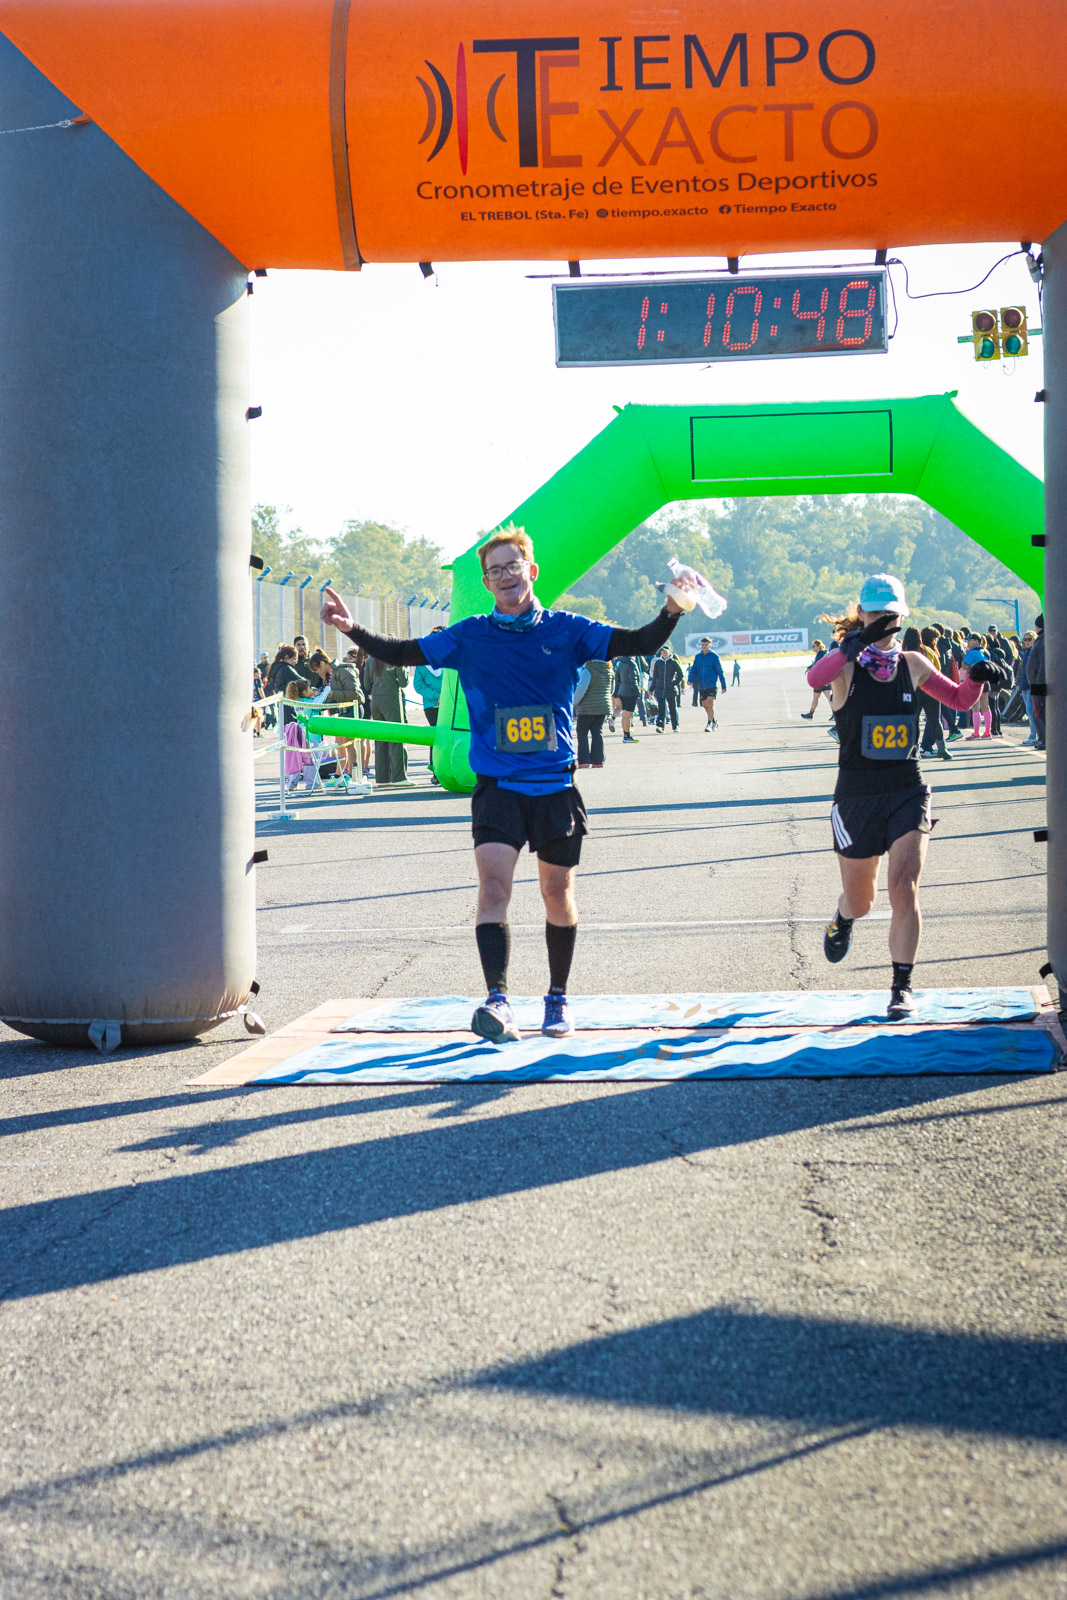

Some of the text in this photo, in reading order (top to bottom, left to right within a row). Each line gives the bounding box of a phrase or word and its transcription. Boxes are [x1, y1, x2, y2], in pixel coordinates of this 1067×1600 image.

[416, 170, 878, 200] Cronometraje de Eventos Deportivos
[460, 201, 837, 222] EL TREBOL (Sta. Fe) tiempo.exacto Tiempo Exacto
[754, 633, 799, 643] LONG
[507, 717, 545, 742] 685
[872, 725, 908, 748] 623
